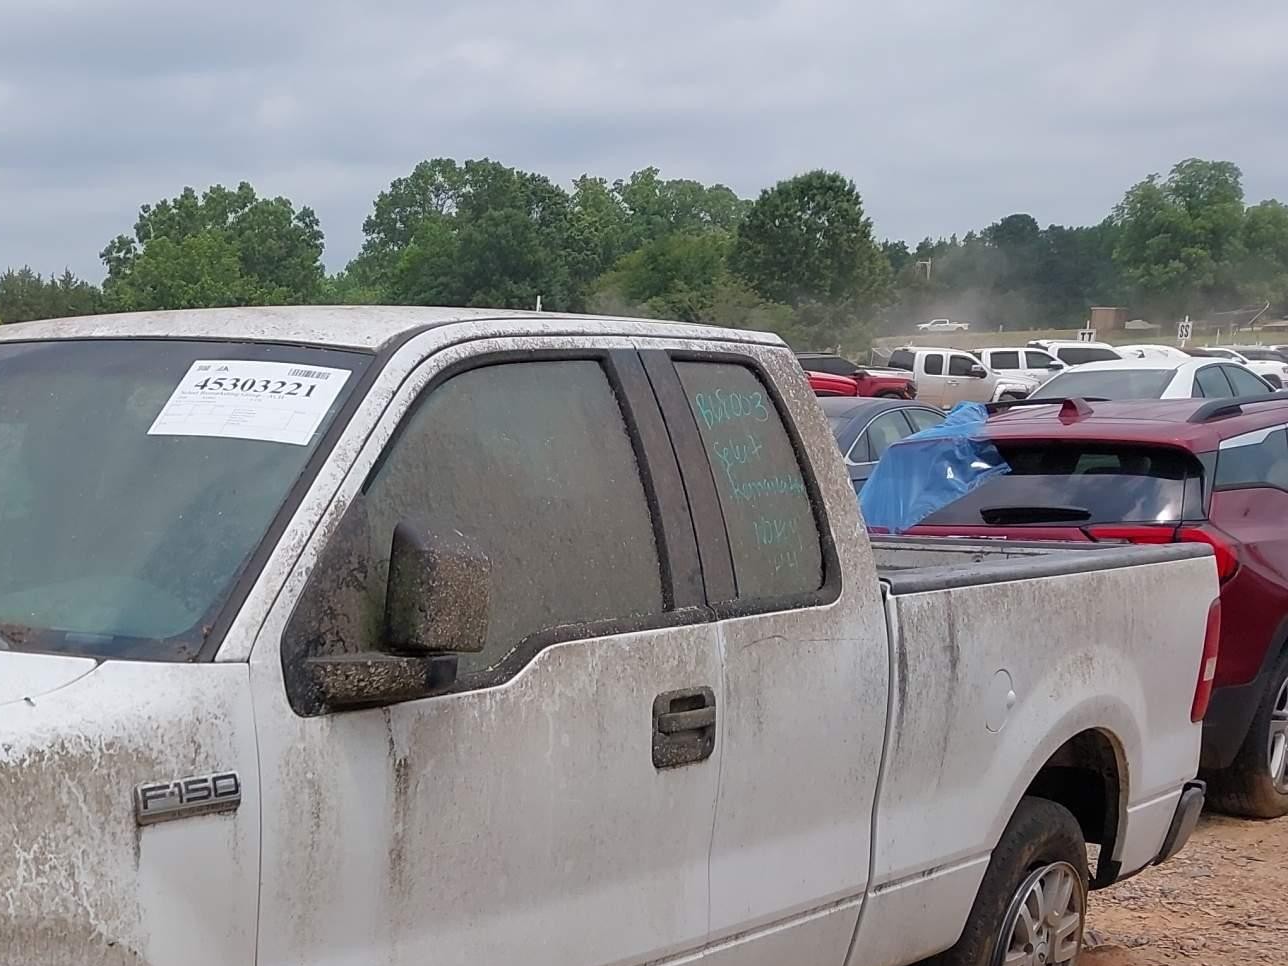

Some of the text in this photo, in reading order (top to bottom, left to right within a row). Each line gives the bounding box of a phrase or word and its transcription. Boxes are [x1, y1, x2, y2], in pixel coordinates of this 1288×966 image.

[1080, 332, 1094, 341] TT
[1179, 324, 1190, 338] SS
[194, 377, 317, 397] 45303221
